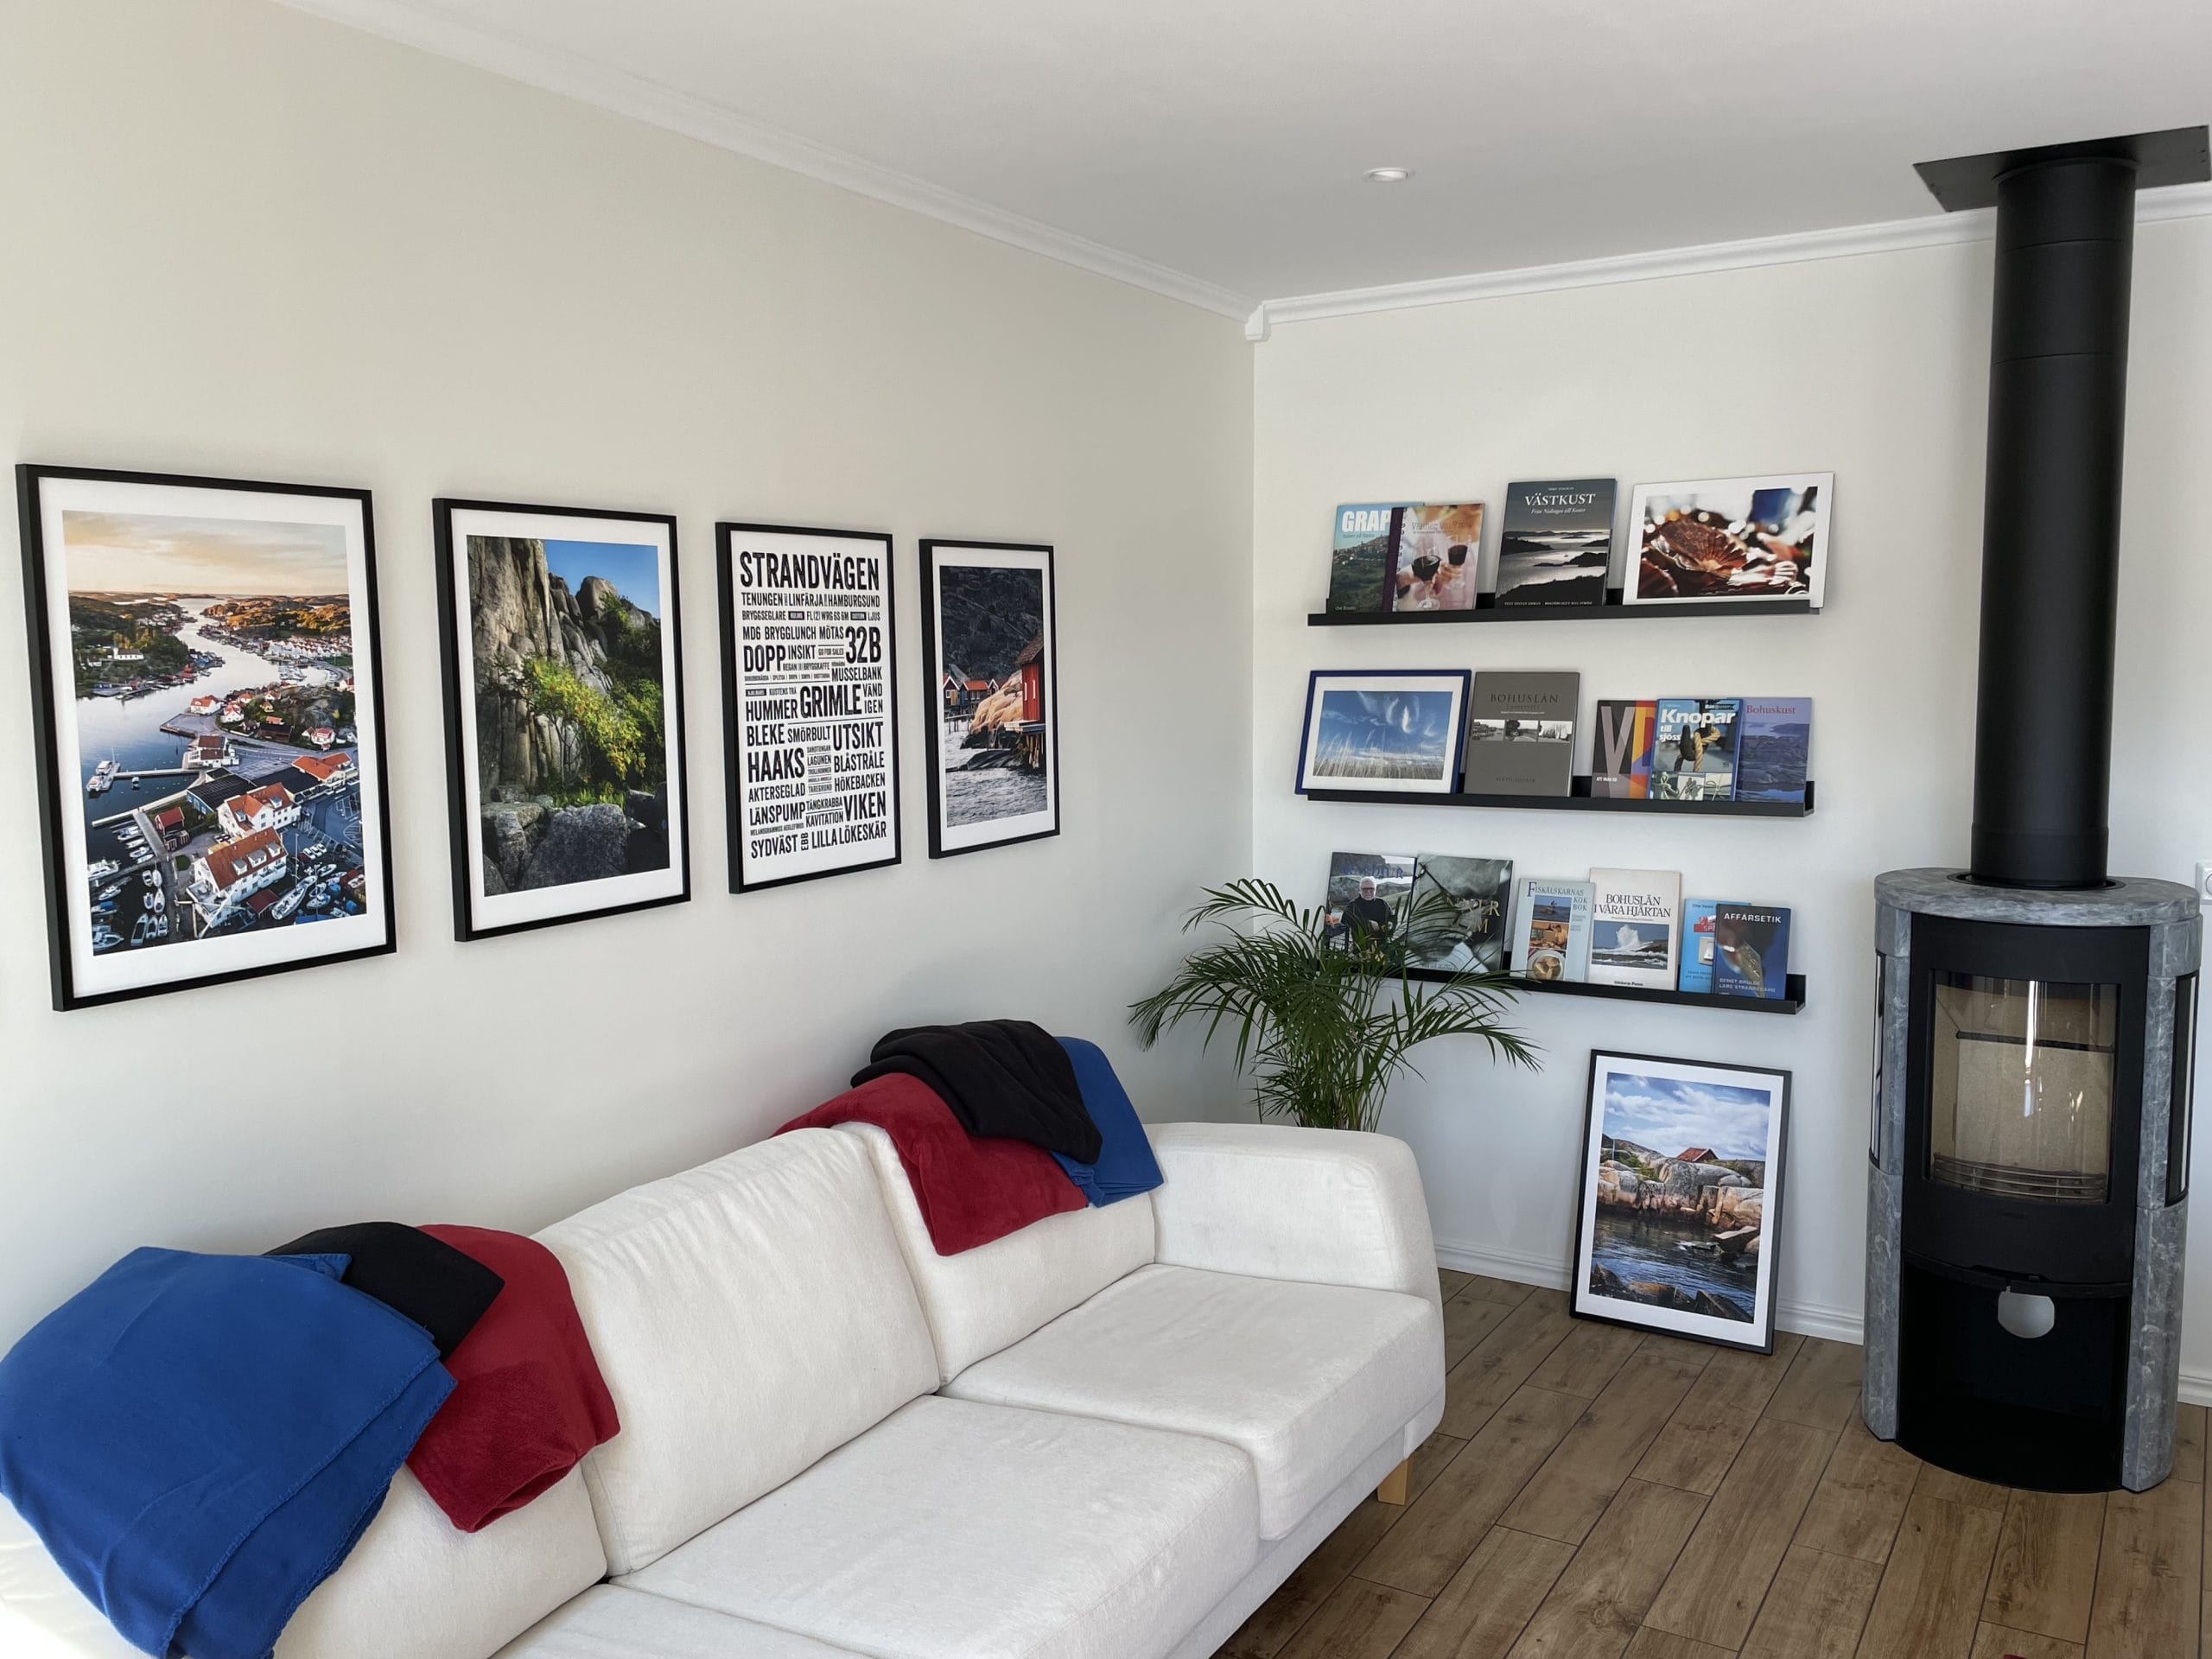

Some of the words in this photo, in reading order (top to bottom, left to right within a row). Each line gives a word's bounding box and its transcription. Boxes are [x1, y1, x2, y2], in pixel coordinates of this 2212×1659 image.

[1525, 493, 1596, 505] VÄSTKUST
[740, 551, 880, 590] STRANDVÄGEN
[741, 592, 783, 607] TENUNGEN
[828, 594, 880, 607] HAMBURGSUND
[742, 611, 786, 620] BRYGGSEGLARE
[868, 612, 880, 620] LJUS
[743, 626, 760, 640] MD6
[765, 626, 817, 639] BRYGGLUNCH
[819, 625, 844, 639] MÖTAS
[845, 626, 881, 663] 32B
[743, 645, 785, 672] DOPP
[788, 645, 816, 659] INSIKT
[832, 666, 882, 682] MUSSELBANK
[746, 699, 798, 721] HUMMER
[800, 683, 862, 719] GRIMLE
[864, 699, 883, 715] IGEN
[1746, 704, 1796, 715] Bohuskust
[1661, 709, 1736, 728] Knopar
[1661, 724, 1672, 733] till
[747, 723, 785, 747] BLEKE
[787, 725, 831, 743] SMÖRBULT
[833, 721, 884, 751] UTSIKT
[747, 747, 804, 783] HAAKS
[834, 750, 885, 773] BLÅSTRÅLE
[834, 772, 886, 792] HÖKEBACKEN
[748, 783, 805, 803] AKTERSEGLAD
[750, 802, 805, 826] LÄNSPUMP
[843, 791, 887, 821] VIKEN
[806, 811, 843, 827] KAVITATION
[751, 832, 798, 858] SYDVÄST
[811, 827, 837, 849] LILLA
[839, 821, 887, 844] LÖKESKÄR
[1605, 893, 1661, 906] BOHUSLÄN
[1626, 906, 1671, 918] HJÄRTAN
